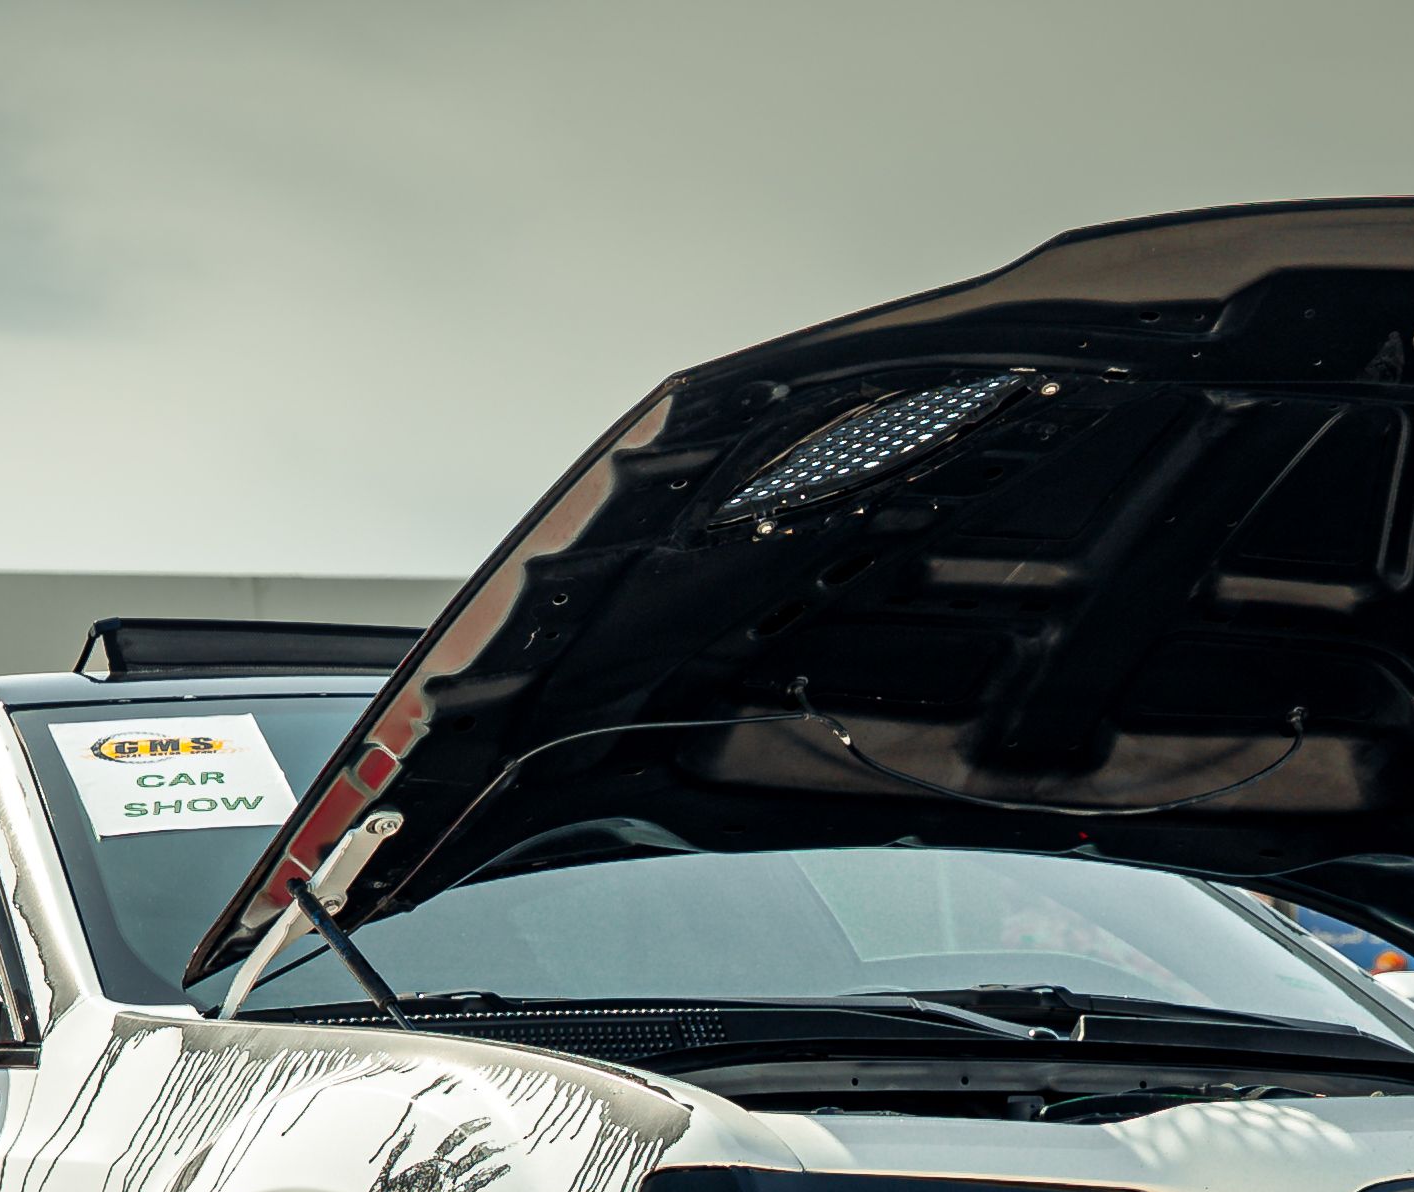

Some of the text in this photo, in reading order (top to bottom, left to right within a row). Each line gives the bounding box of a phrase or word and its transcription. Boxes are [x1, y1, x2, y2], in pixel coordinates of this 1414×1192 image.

[115, 737, 214, 754] GMS
[137, 772, 225, 787] CAR
[124, 796, 264, 817] SHOW
